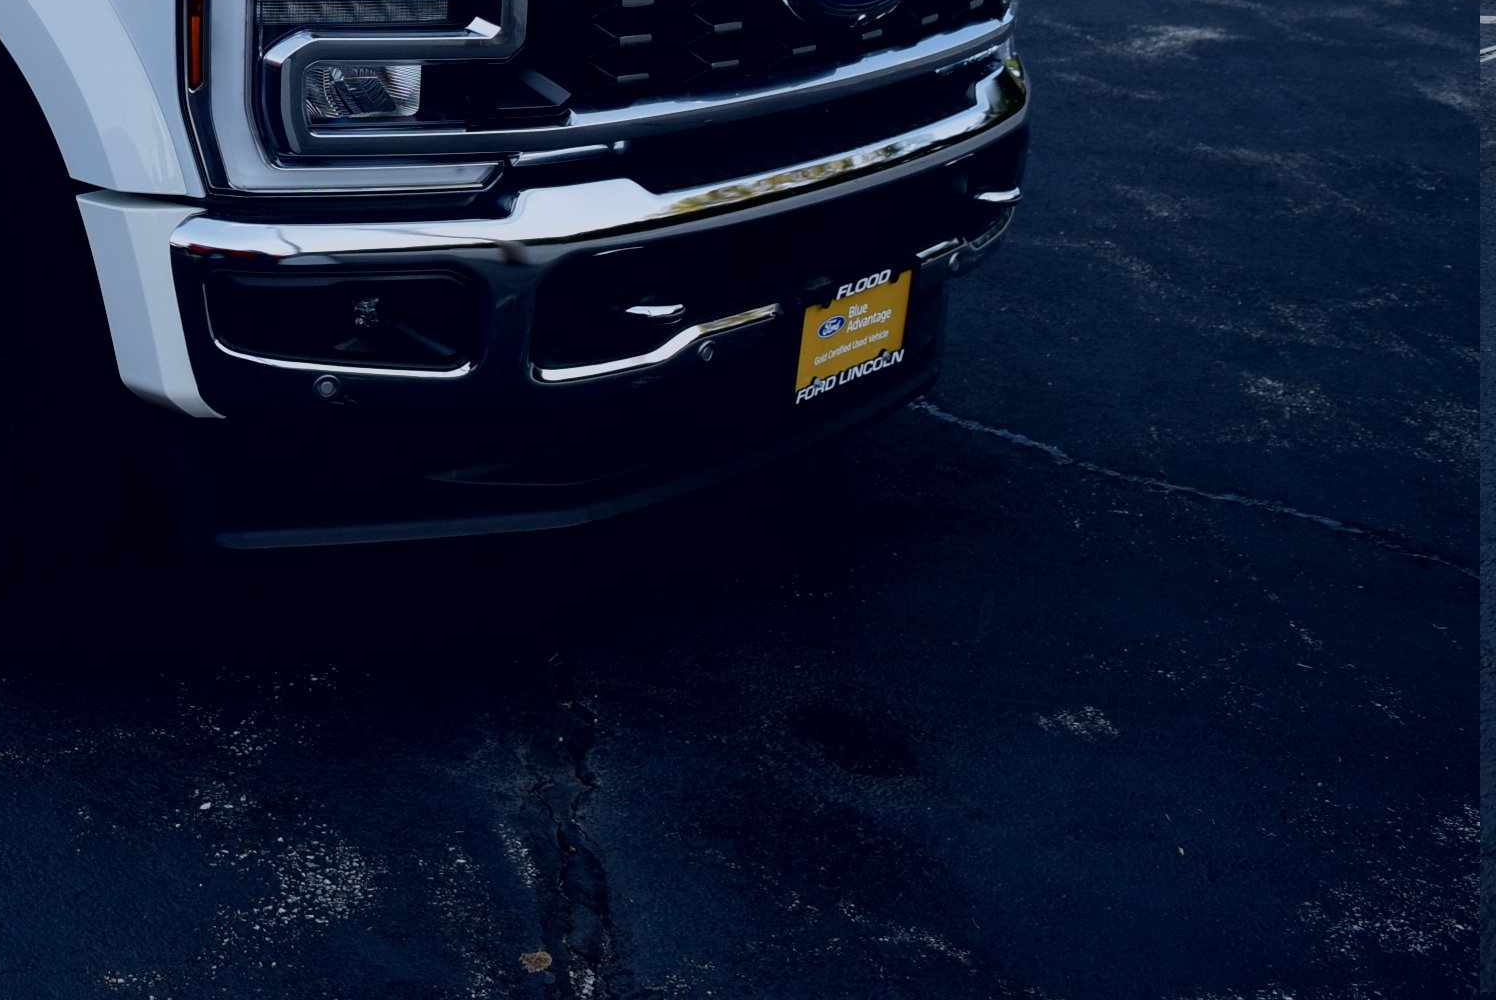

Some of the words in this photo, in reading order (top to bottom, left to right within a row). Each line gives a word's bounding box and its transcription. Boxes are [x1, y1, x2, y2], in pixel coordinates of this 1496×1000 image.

[836, 269, 891, 300] FLOOD
[822, 318, 841, 335] Ford
[849, 304, 868, 318] Blue
[847, 309, 892, 332] Advantage
[815, 353, 827, 365] Gold
[828, 343, 851, 360] Certified
[852, 337, 868, 349] Used
[869, 330, 888, 343] Vehicle
[796, 376, 837, 404] FORD
